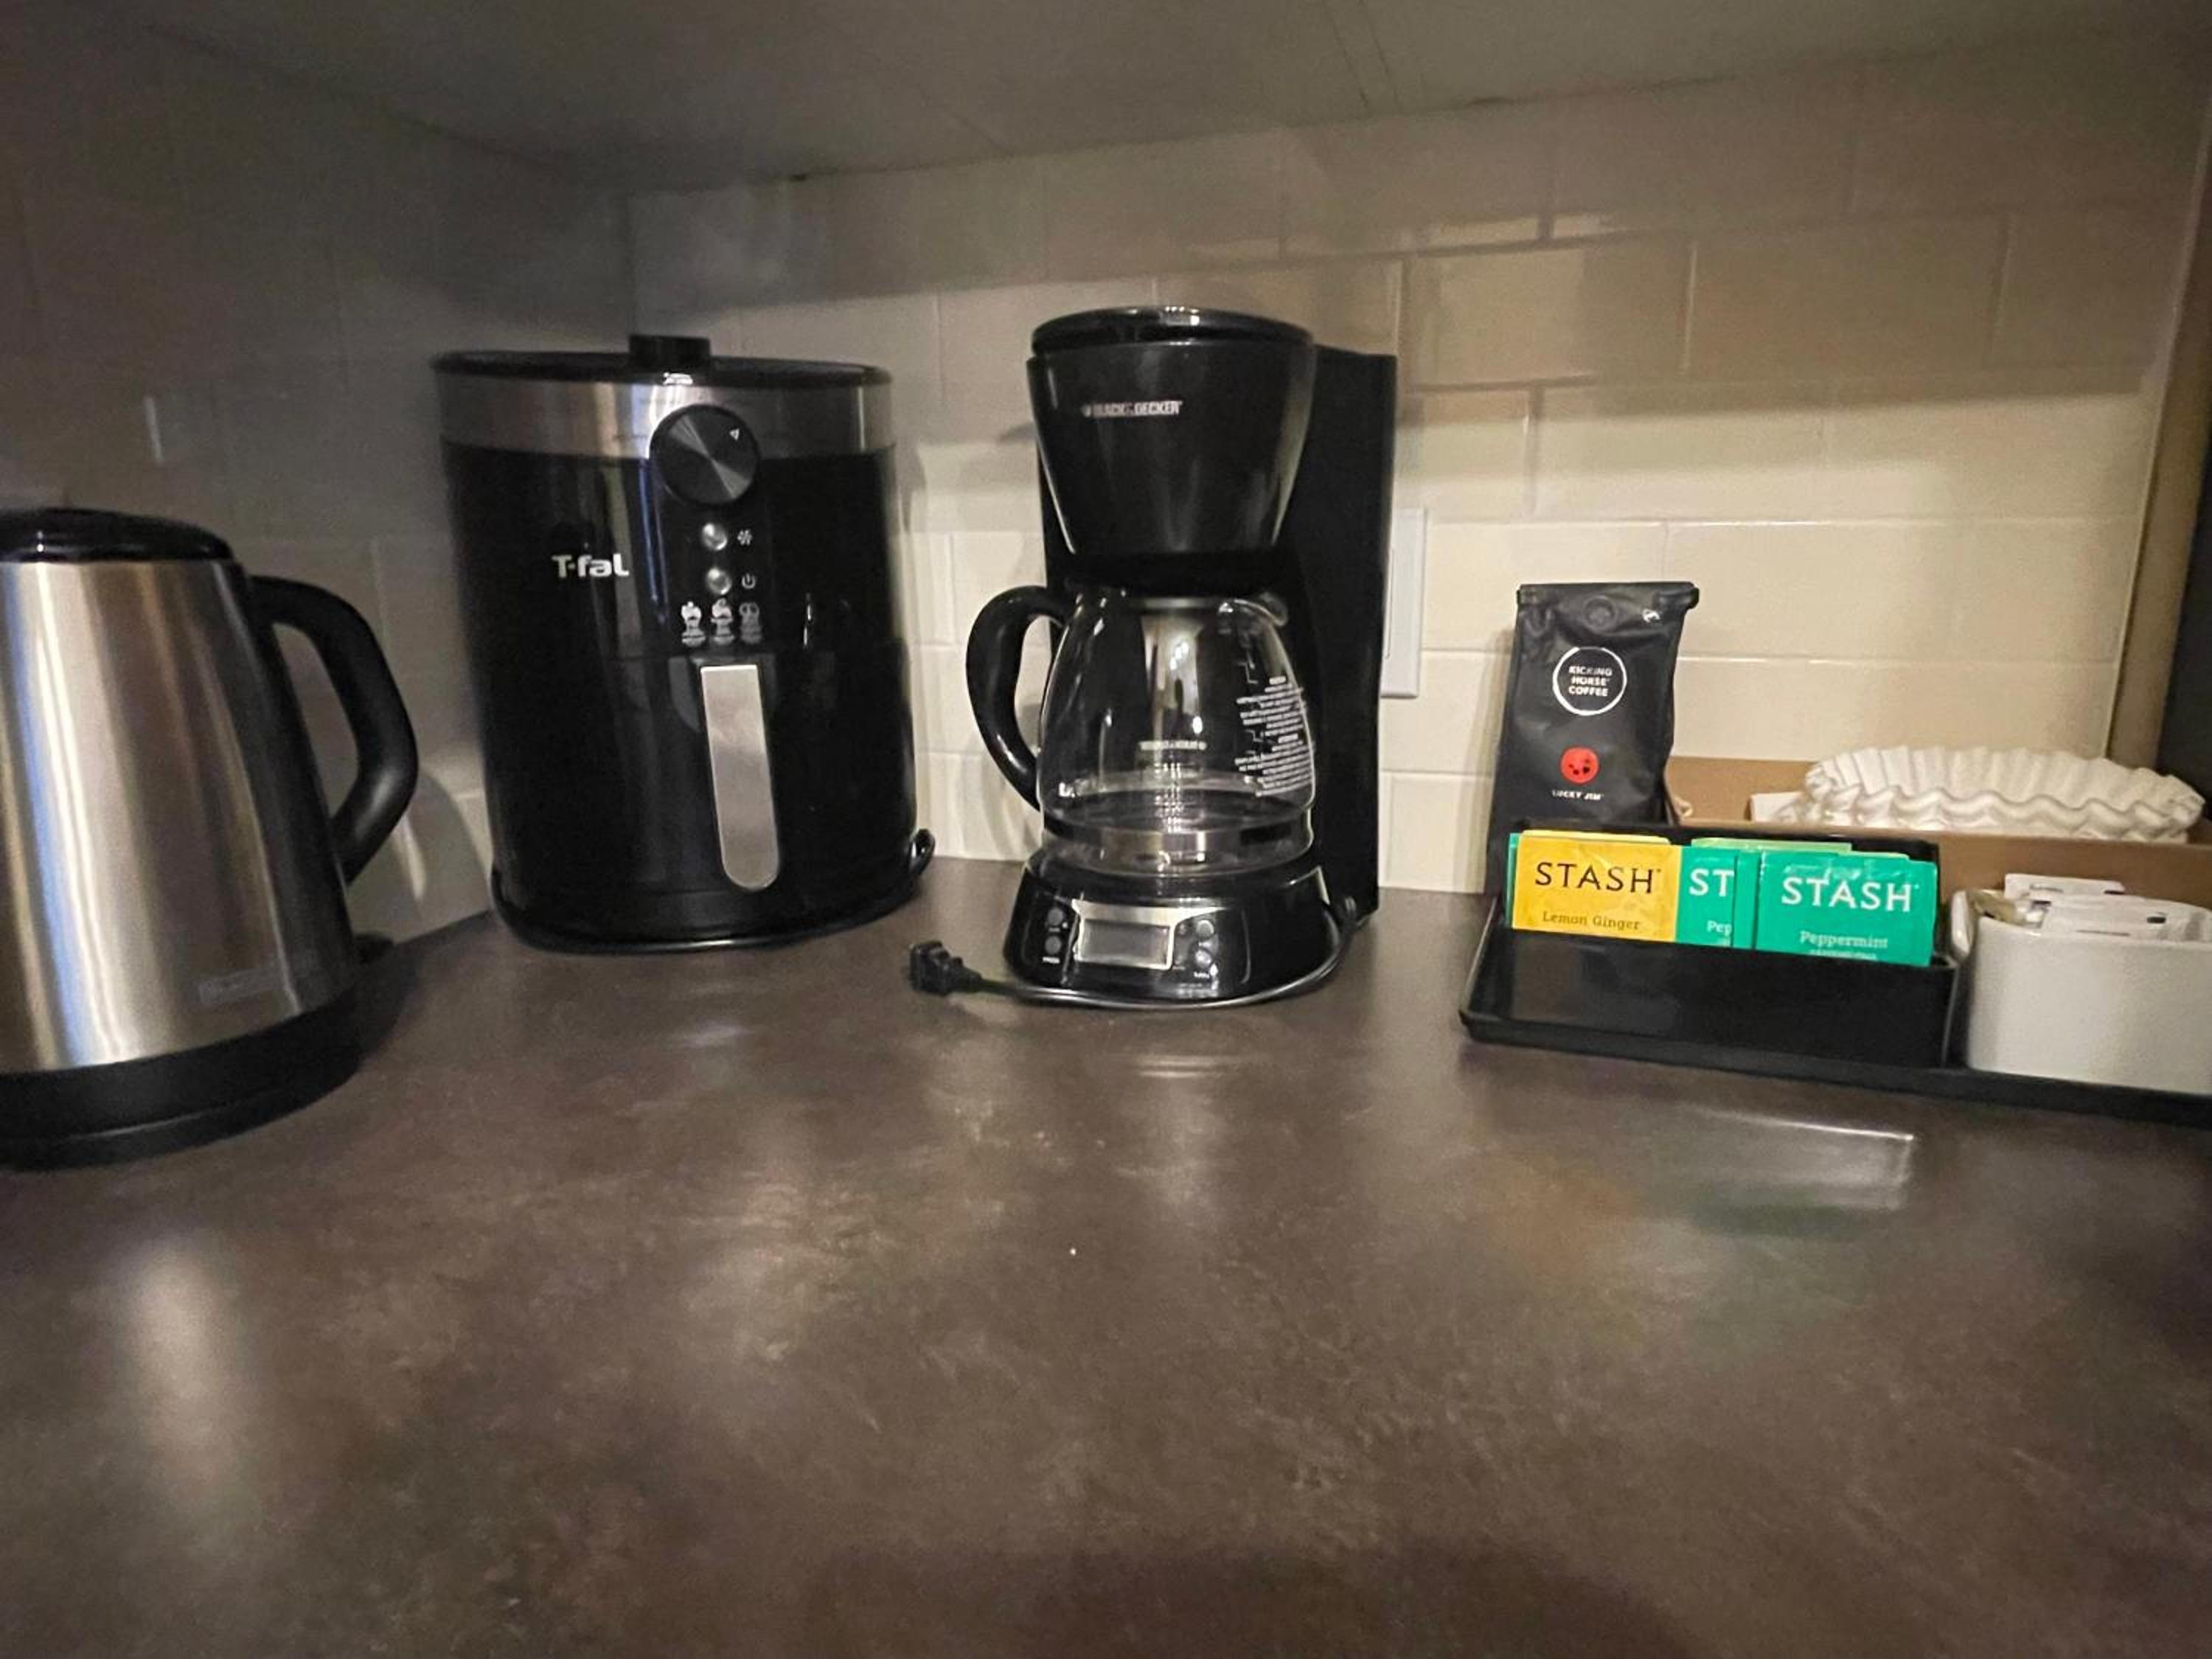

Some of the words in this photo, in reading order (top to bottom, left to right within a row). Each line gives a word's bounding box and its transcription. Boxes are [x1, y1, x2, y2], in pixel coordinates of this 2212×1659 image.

[1568, 686, 1609, 697] COFFEE
[1535, 862, 1654, 894] STASH
[1781, 877, 1912, 912] STASH
[1543, 911, 1587, 926] Lemon
[1593, 914, 1641, 931] Ginger
[1799, 930, 1888, 949] Peppermint
